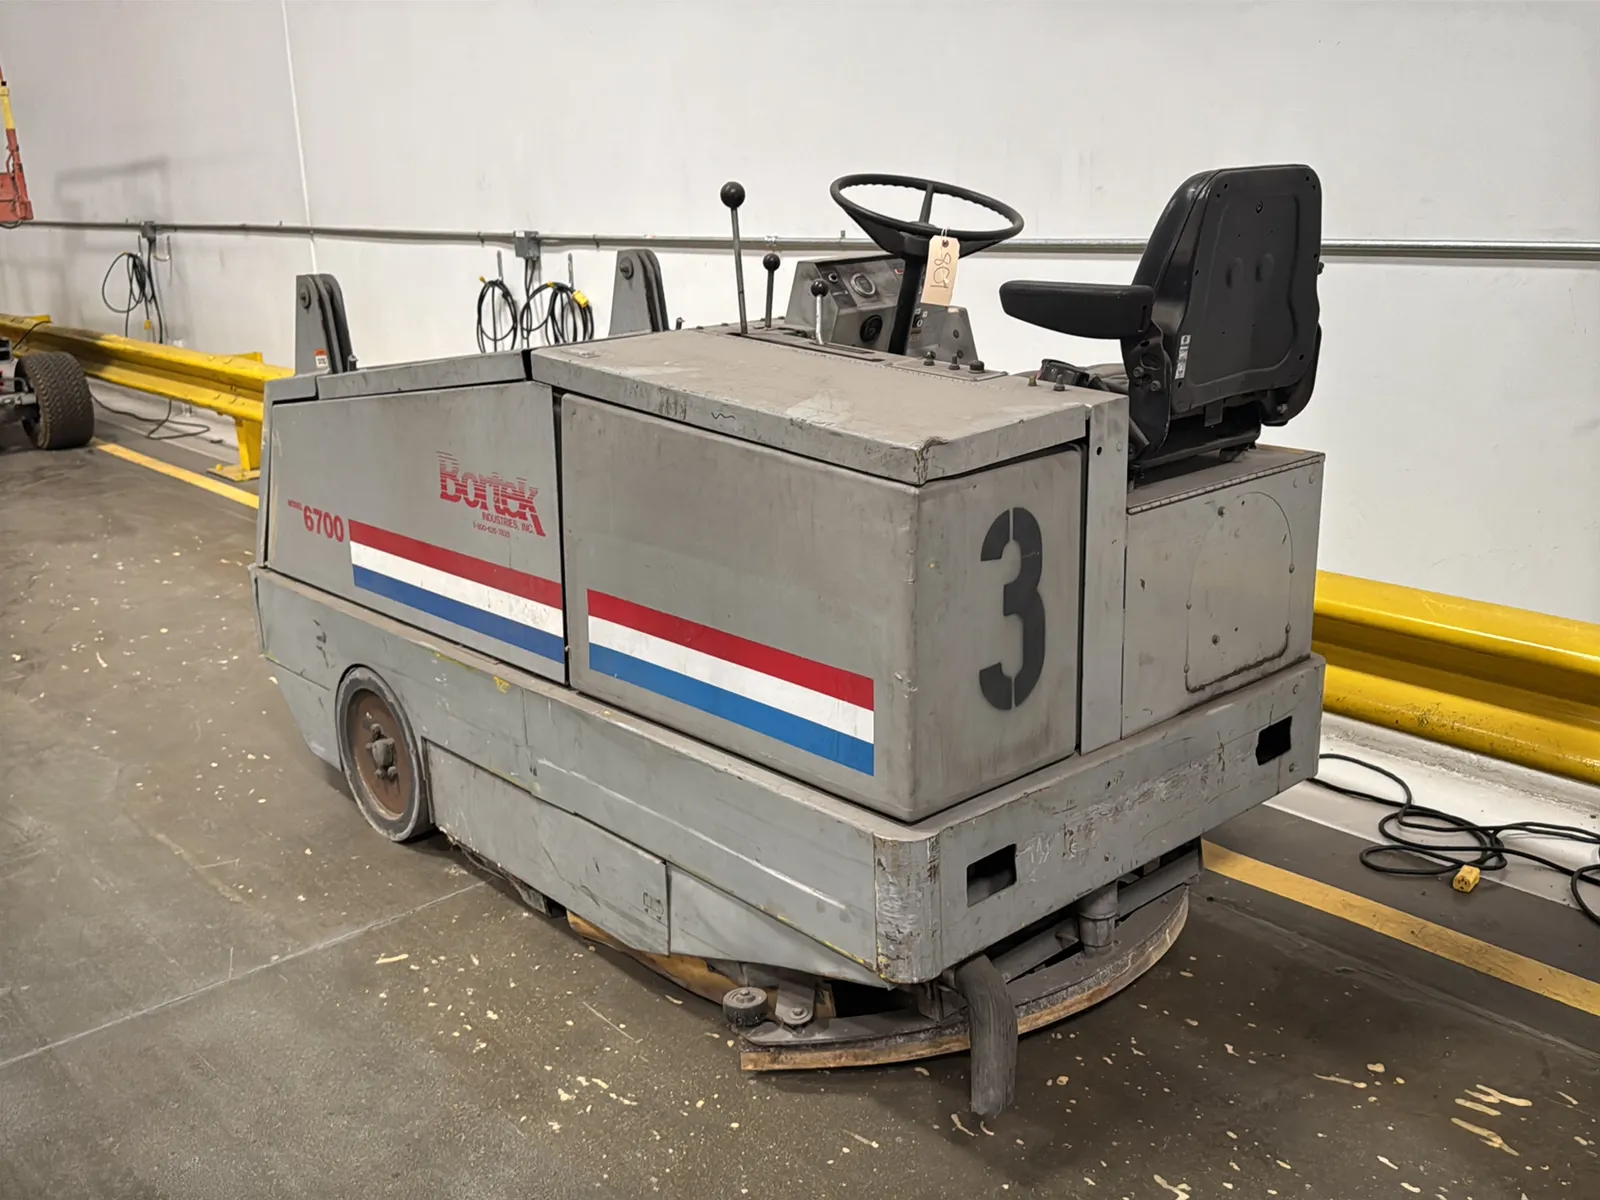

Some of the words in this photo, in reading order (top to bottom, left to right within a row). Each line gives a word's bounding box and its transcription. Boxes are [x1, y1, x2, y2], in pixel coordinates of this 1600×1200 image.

[303, 505, 345, 543] 6700
[437, 450, 546, 537] Bortek
[979, 506, 1046, 711] 3
